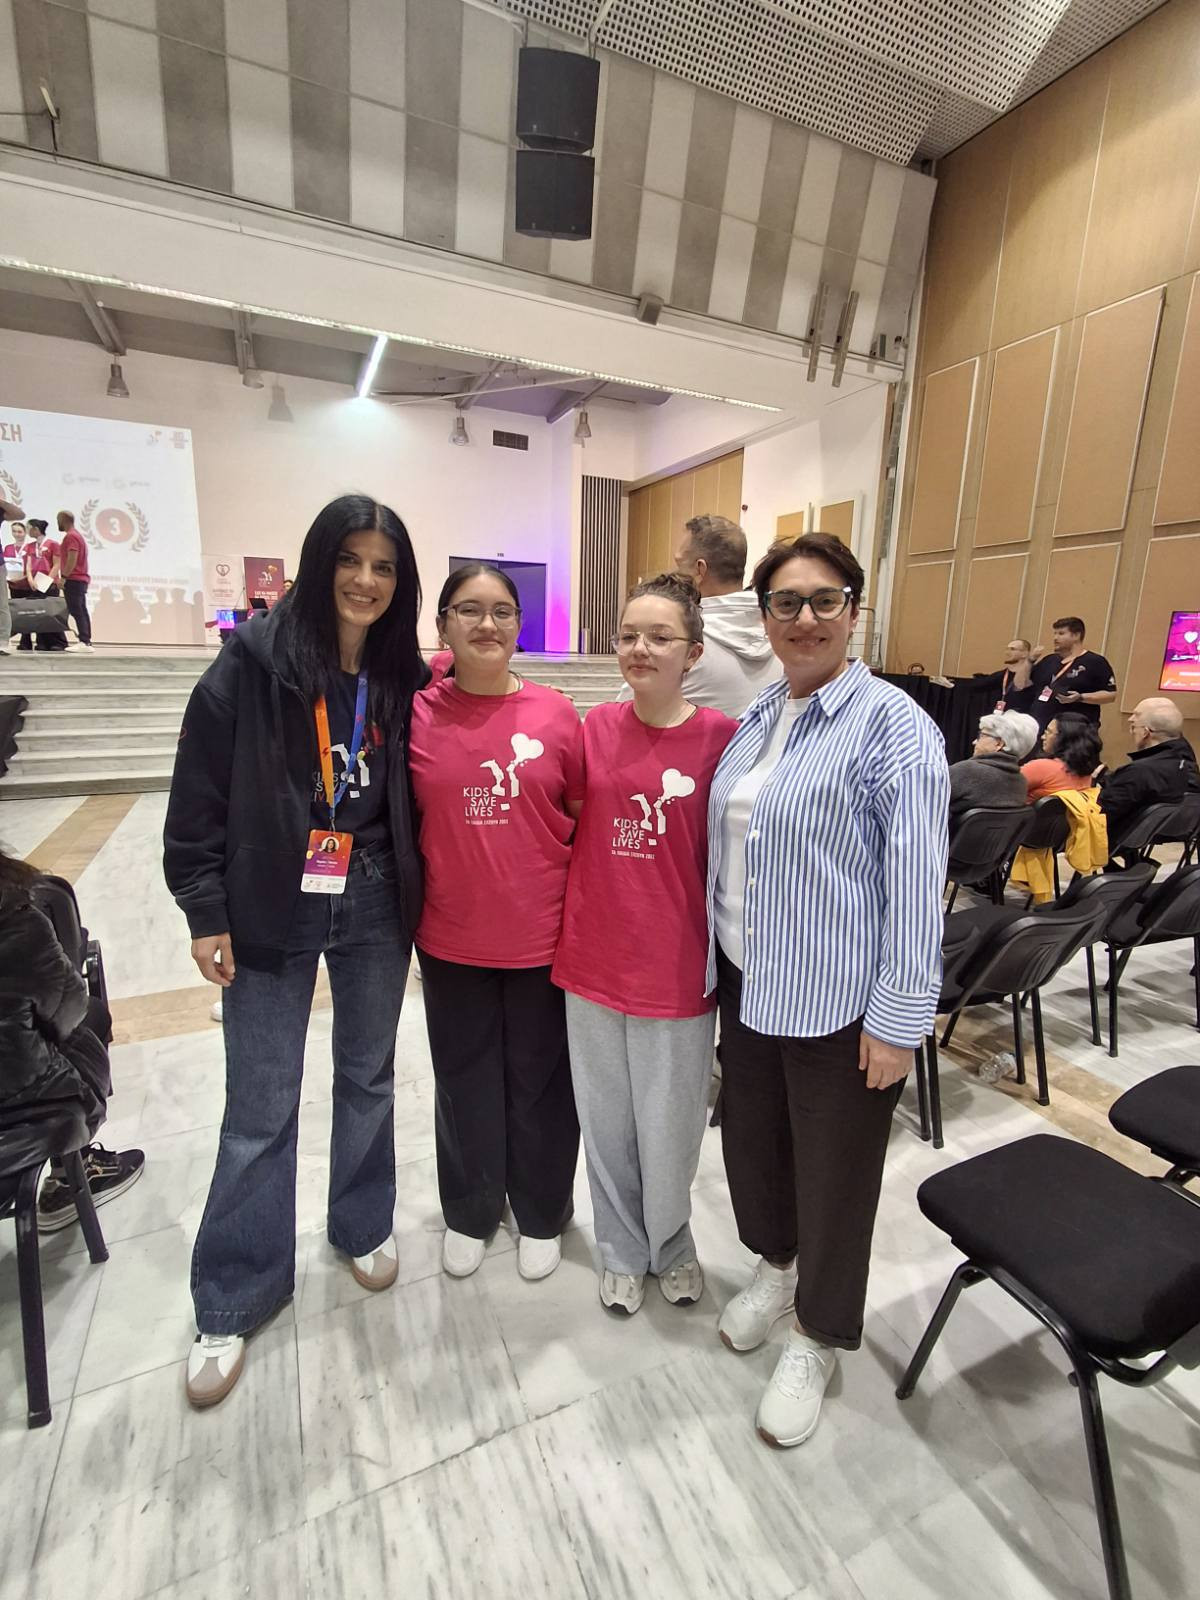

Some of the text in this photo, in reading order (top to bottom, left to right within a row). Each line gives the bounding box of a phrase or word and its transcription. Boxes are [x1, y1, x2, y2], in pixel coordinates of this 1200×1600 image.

[108, 517, 122, 536] 3
[463, 786, 490, 797] KIDS
[470, 796, 497, 807] SAVE
[464, 806, 494, 817] LIVES
[613, 817, 639, 830] KIDS
[619, 828, 645, 841] SAVE
[612, 836, 641, 850] LIVES
